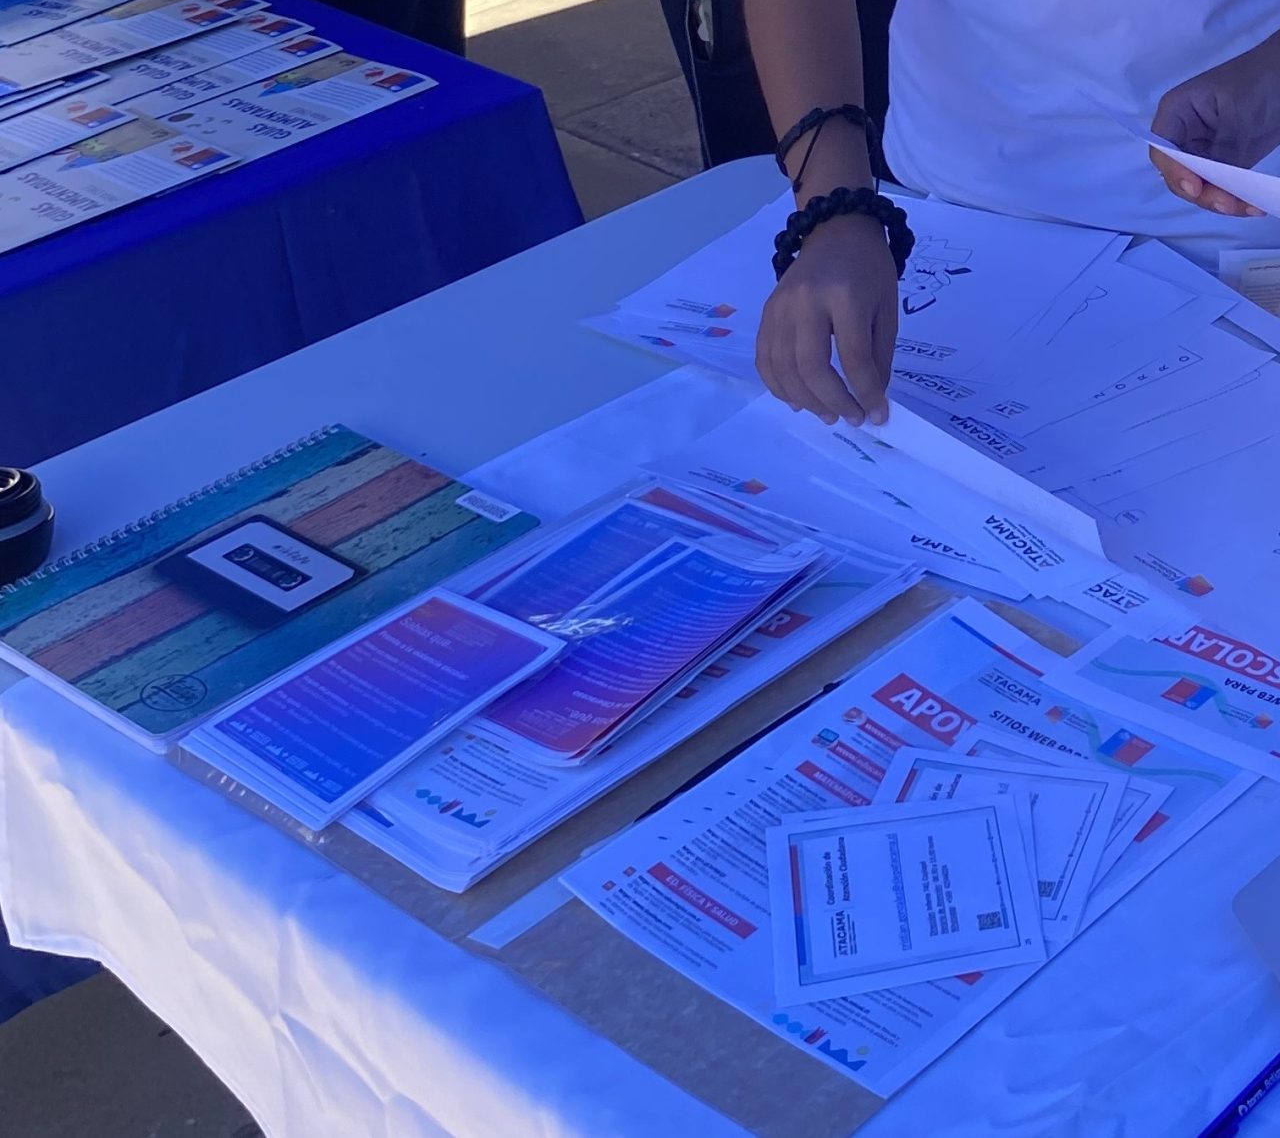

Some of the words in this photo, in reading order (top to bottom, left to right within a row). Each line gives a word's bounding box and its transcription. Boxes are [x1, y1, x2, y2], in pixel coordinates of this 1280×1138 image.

[129, 63, 171, 80] GUÍAS
[221, 96, 316, 131] ALIMENTARIAS
[245, 122, 292, 140] GUÍAS
[18, 171, 104, 212] ALIMENTARIAS
[31, 203, 75, 223] GUÍAS
[949, 412, 1016, 460] ATACAMA
[984, 512, 1054, 573] ATACAMA
[982, 668, 1044, 707] ATACAMA
[1223, 676, 1258, 698] PARA
[989, 708, 1030, 736] SITIOS
[1027, 728, 1058, 750] WEB
[822, 851, 831, 859] de
[836, 836, 848, 871] Ciudadana
[678, 881, 708, 907] FÍSICA
[704, 899, 715, 911] Y
[710, 903, 740, 928] SALUD
[836, 909, 849, 956] ATACAMA
